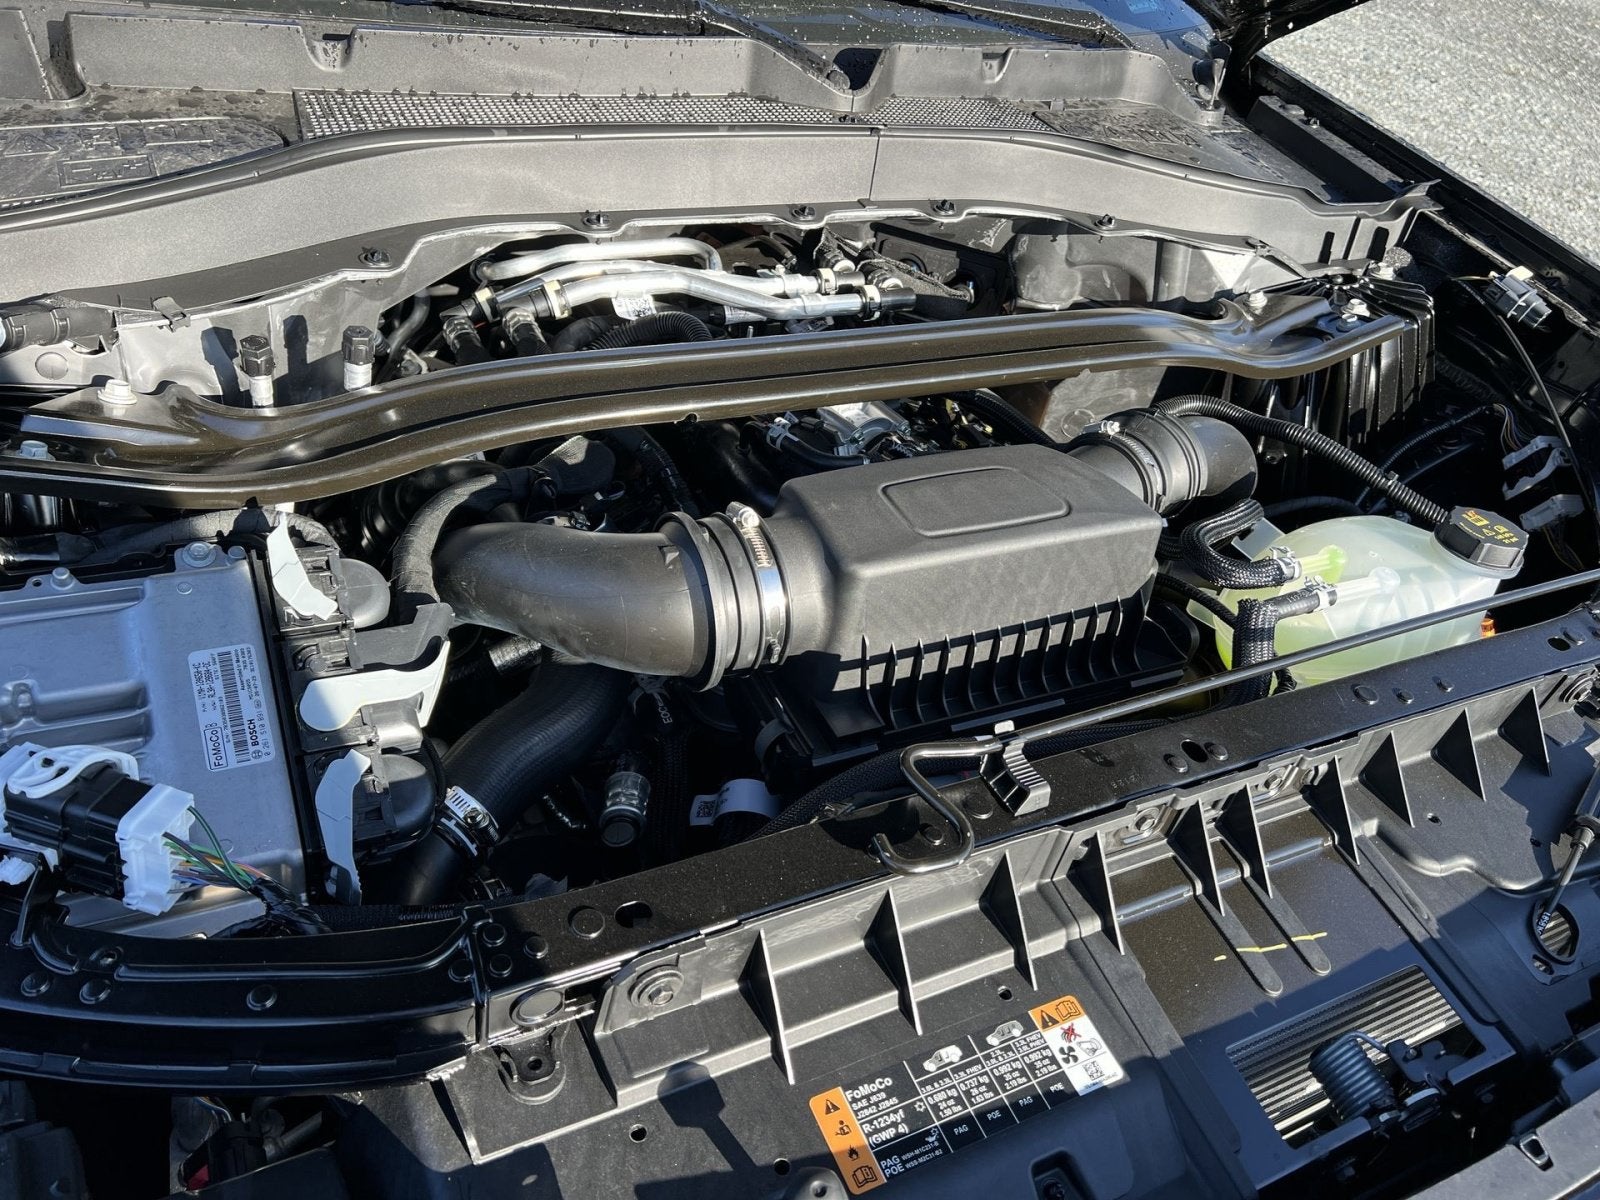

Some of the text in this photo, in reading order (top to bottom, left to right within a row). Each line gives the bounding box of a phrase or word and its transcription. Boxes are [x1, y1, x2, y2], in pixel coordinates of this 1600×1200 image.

[247, 719, 259, 746] BOSCH
[210, 730, 223, 767] FoMoCo
[1024, 1049, 1052, 1063] 0.992 kg
[966, 1064, 982, 1074] FHEV
[993, 1061, 1022, 1076] 0.992 kg
[1035, 1067, 1048, 1077] 2.19
[960, 1075, 989, 1091] 0.737 kg
[1004, 1073, 1012, 1081] 35
[845, 1078, 892, 1101] FoMoCo
[1005, 1080, 1018, 1089] 2.19
[1050, 1082, 1065, 1092] POE
[927, 1088, 958, 1104] 0.680 kg
[970, 1088, 979, 1096] 26
[852, 1092, 886, 1110] SAE J639
[938, 1101, 947, 1109] 24
[971, 1095, 984, 1104] 1.63
[1019, 1096, 1033, 1106] PAG
[857, 1097, 898, 1119] J2842 J2845
[951, 1105, 962, 1113] lbs
[987, 1110, 1001, 1120] POE
[862, 1109, 905, 1133] R-1234yf
[869, 1123, 909, 1147] (GWP 4)
[954, 1125, 968, 1135] PAG
[880, 1155, 900, 1169] PAG
[885, 1163, 904, 1177] POE
